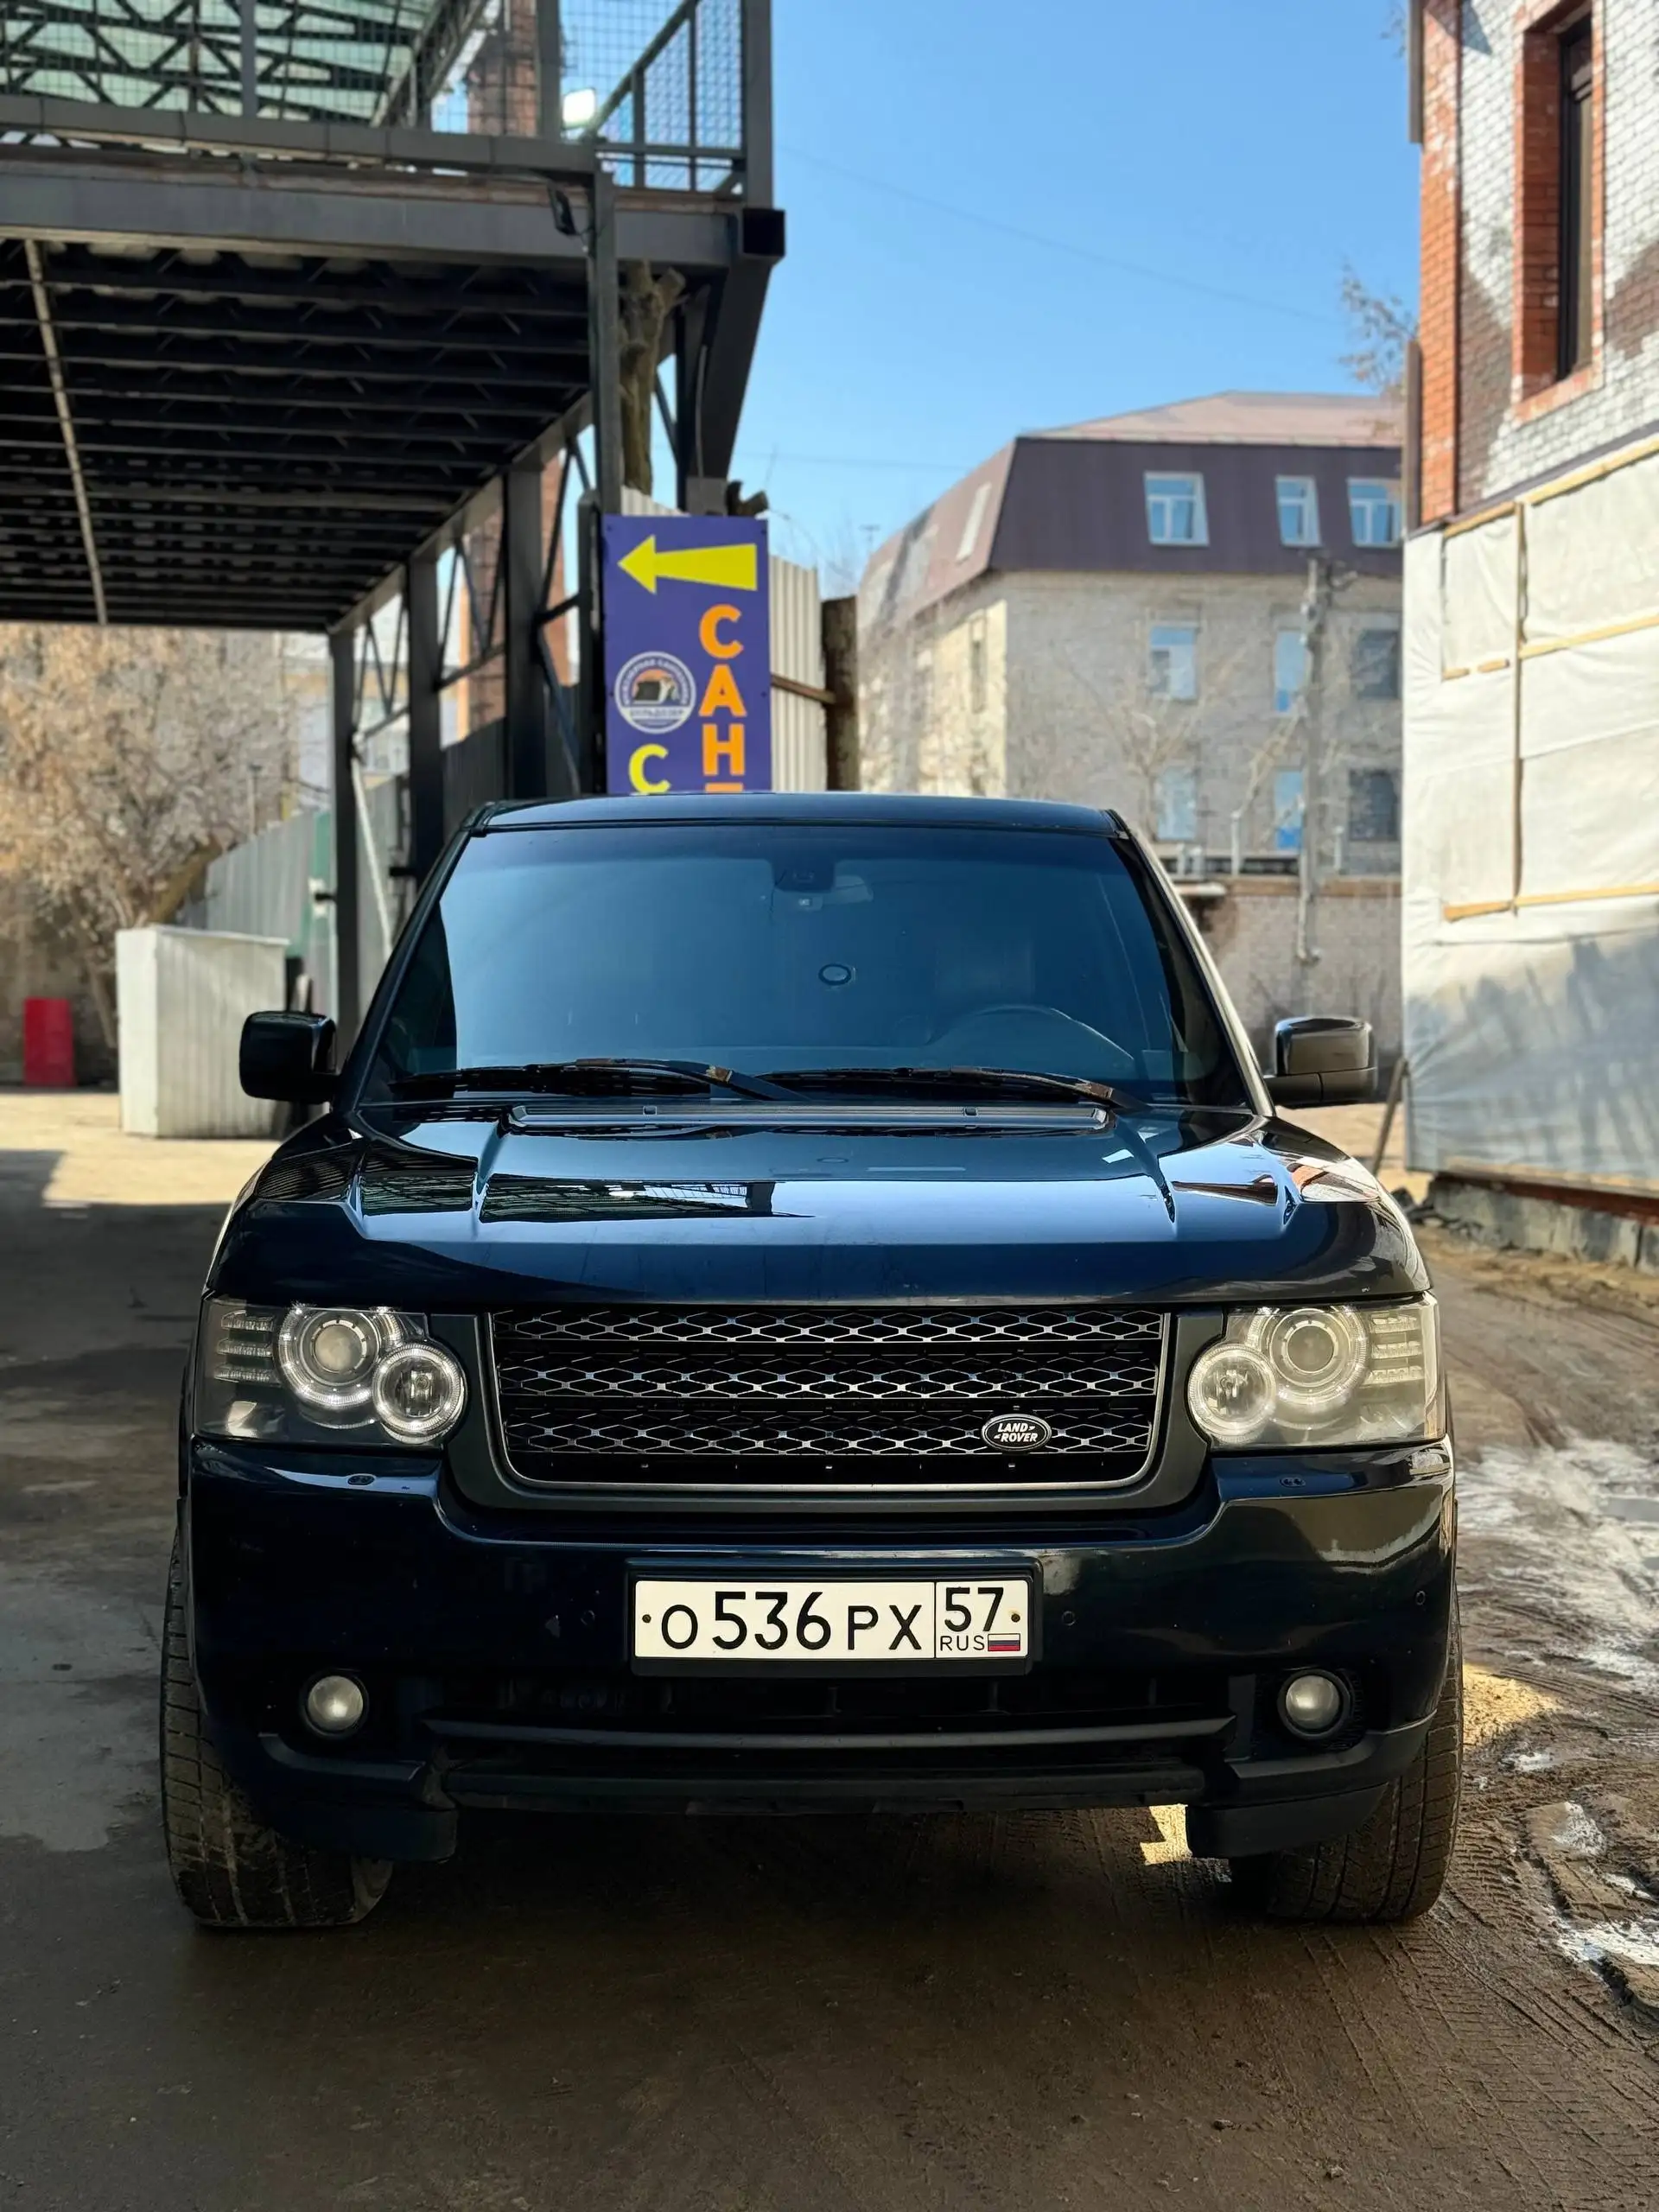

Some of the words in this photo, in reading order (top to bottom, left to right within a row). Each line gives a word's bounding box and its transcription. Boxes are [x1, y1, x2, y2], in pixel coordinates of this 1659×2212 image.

[699, 604, 747, 794] САН
[997, 1422, 1028, 1433] LAND
[1000, 1432, 1039, 1443] ROVER
[944, 1586, 1005, 1632] 57
[939, 1635, 986, 1652] RUS
